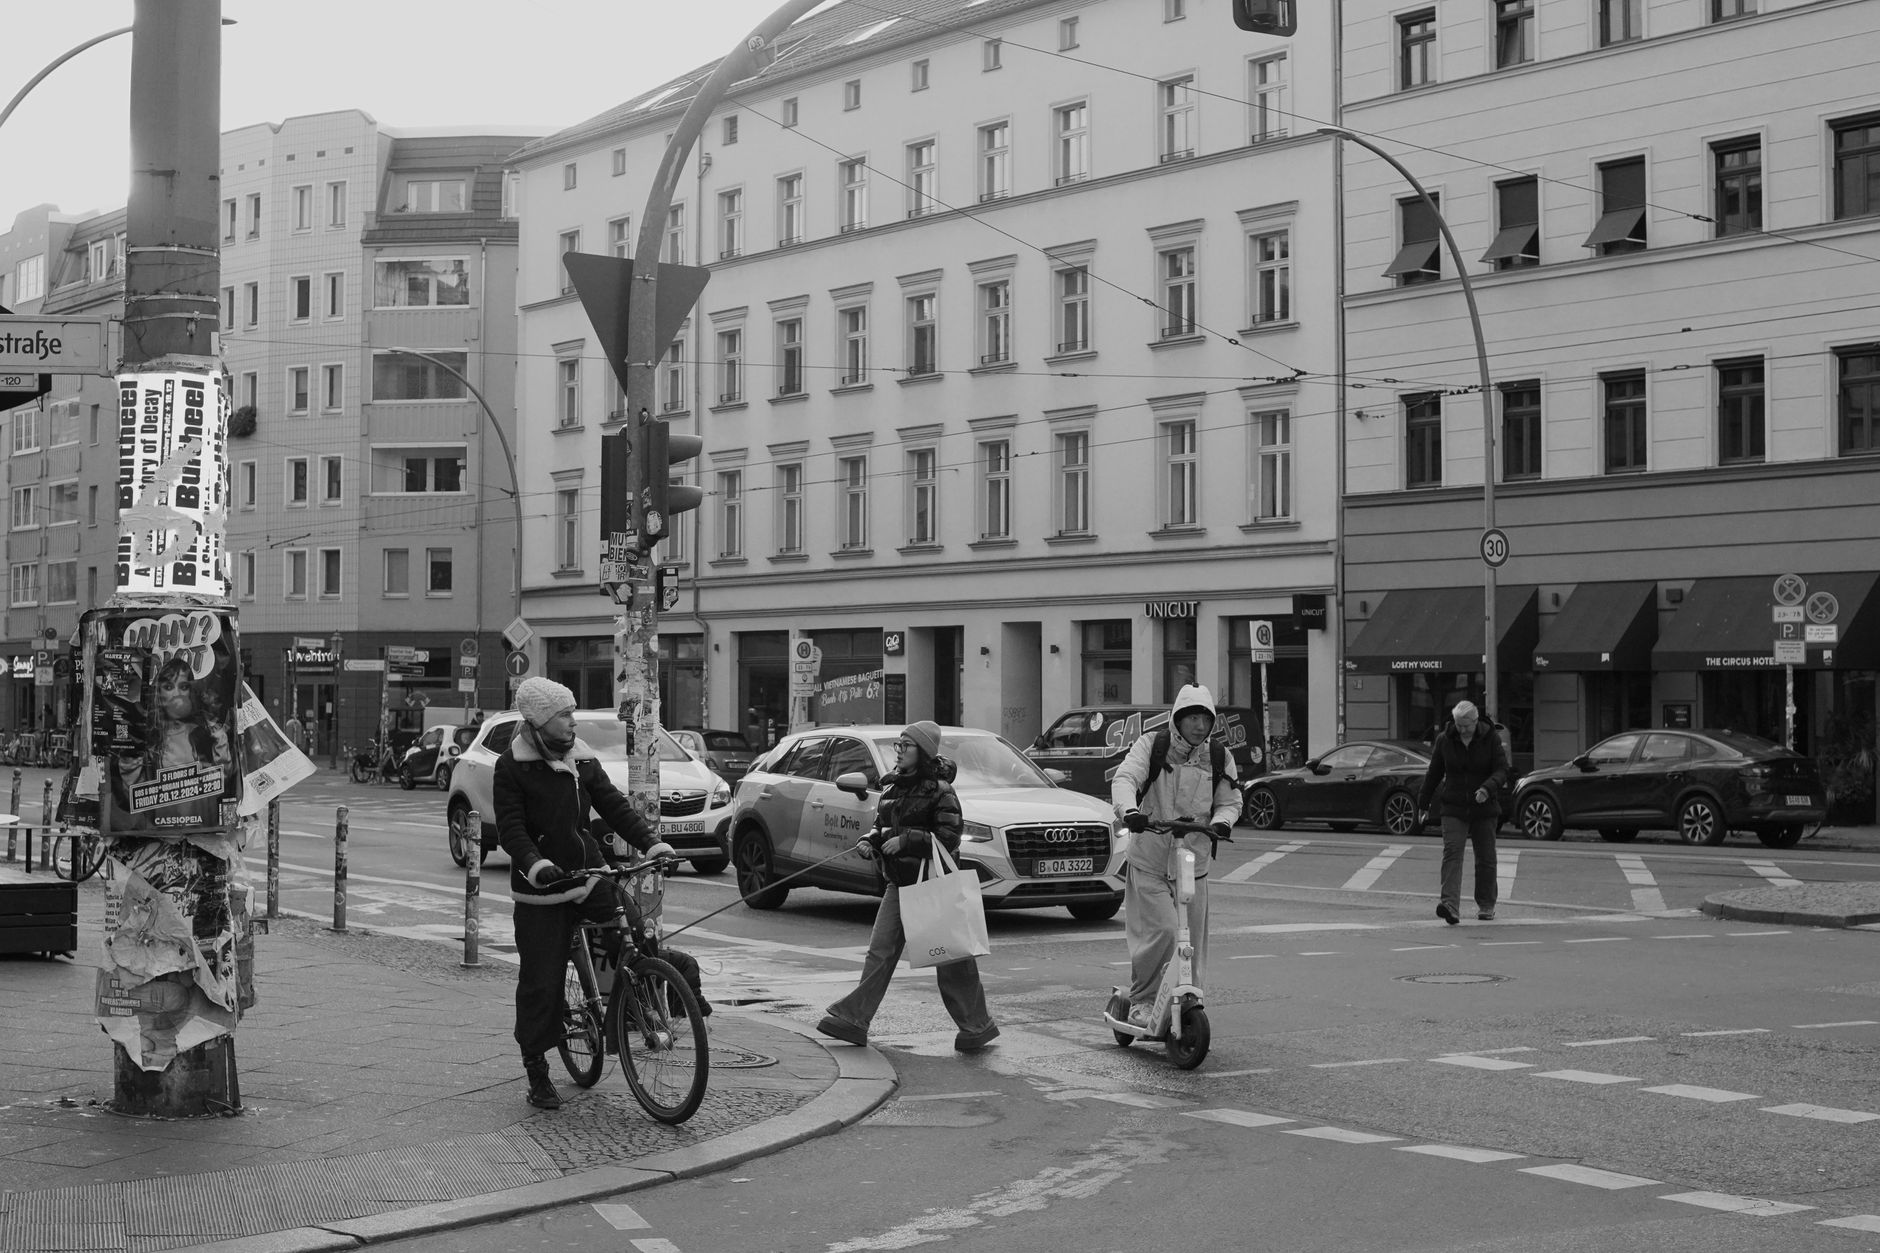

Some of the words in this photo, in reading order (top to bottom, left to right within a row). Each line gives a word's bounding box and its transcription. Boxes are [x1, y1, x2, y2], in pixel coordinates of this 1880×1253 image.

[141, 389, 162, 434] Decay
[140, 438, 157, 453] of
[1486, 539, 1504, 557] 30
[1144, 601, 1198, 617] UNICUT
[1301, 608, 1325, 616] UNICUT
[129, 615, 213, 649] WHY?
[1783, 624, 1794, 638] P
[37, 651, 48, 665] P
[1391, 660, 1408, 669] LOST
[1408, 660, 1418, 669] MY
[1706, 657, 1721, 667] THE
[1722, 657, 1751, 666] CIRCUS
[1753, 657, 1781, 666] HOTE
[823, 674, 857, 691] VIETNAMESE
[858, 668, 883, 683] BAGUETT
[162, 773, 167, 781] 3
[167, 769, 187, 780] FLOORS
[188, 767, 195, 776] OF
[135, 794, 158, 808] FRIDAY
[159, 786, 199, 803] 20.12.2024
[154, 815, 203, 825] CASSIOPEIA
[840, 815, 860, 830] Drive
[1040, 861, 1046, 873] B
[1052, 860, 1066, 872] QA
[1068, 859, 1092, 872] 3322
[928, 946, 946, 957] COS
